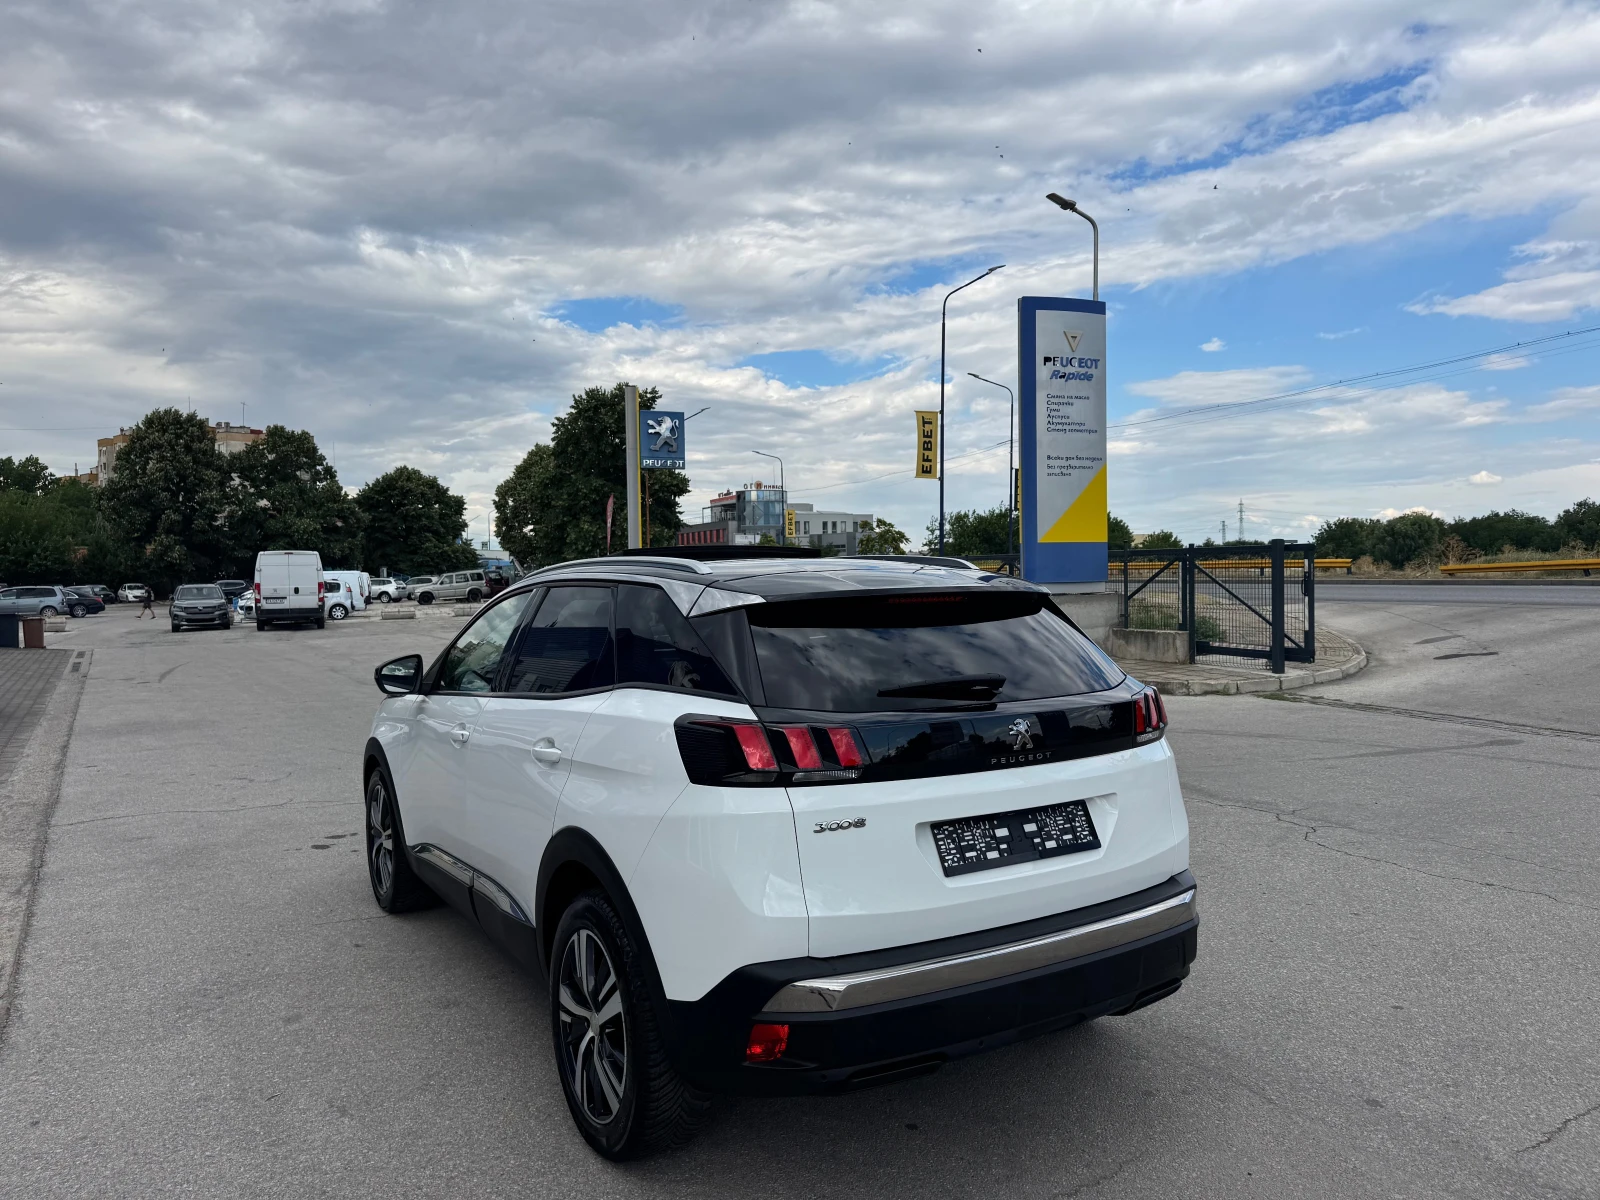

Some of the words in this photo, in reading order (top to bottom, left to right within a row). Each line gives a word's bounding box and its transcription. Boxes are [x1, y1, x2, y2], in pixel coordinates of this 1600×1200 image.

[1043, 356, 1100, 369] PEUGEOT
[1050, 370, 1094, 382] Rapide
[921, 415, 933, 475] EFBET
[643, 459, 684, 467] PEUGEOT
[991, 752, 1052, 764] PEUGEOT
[813, 816, 867, 833] 3008
